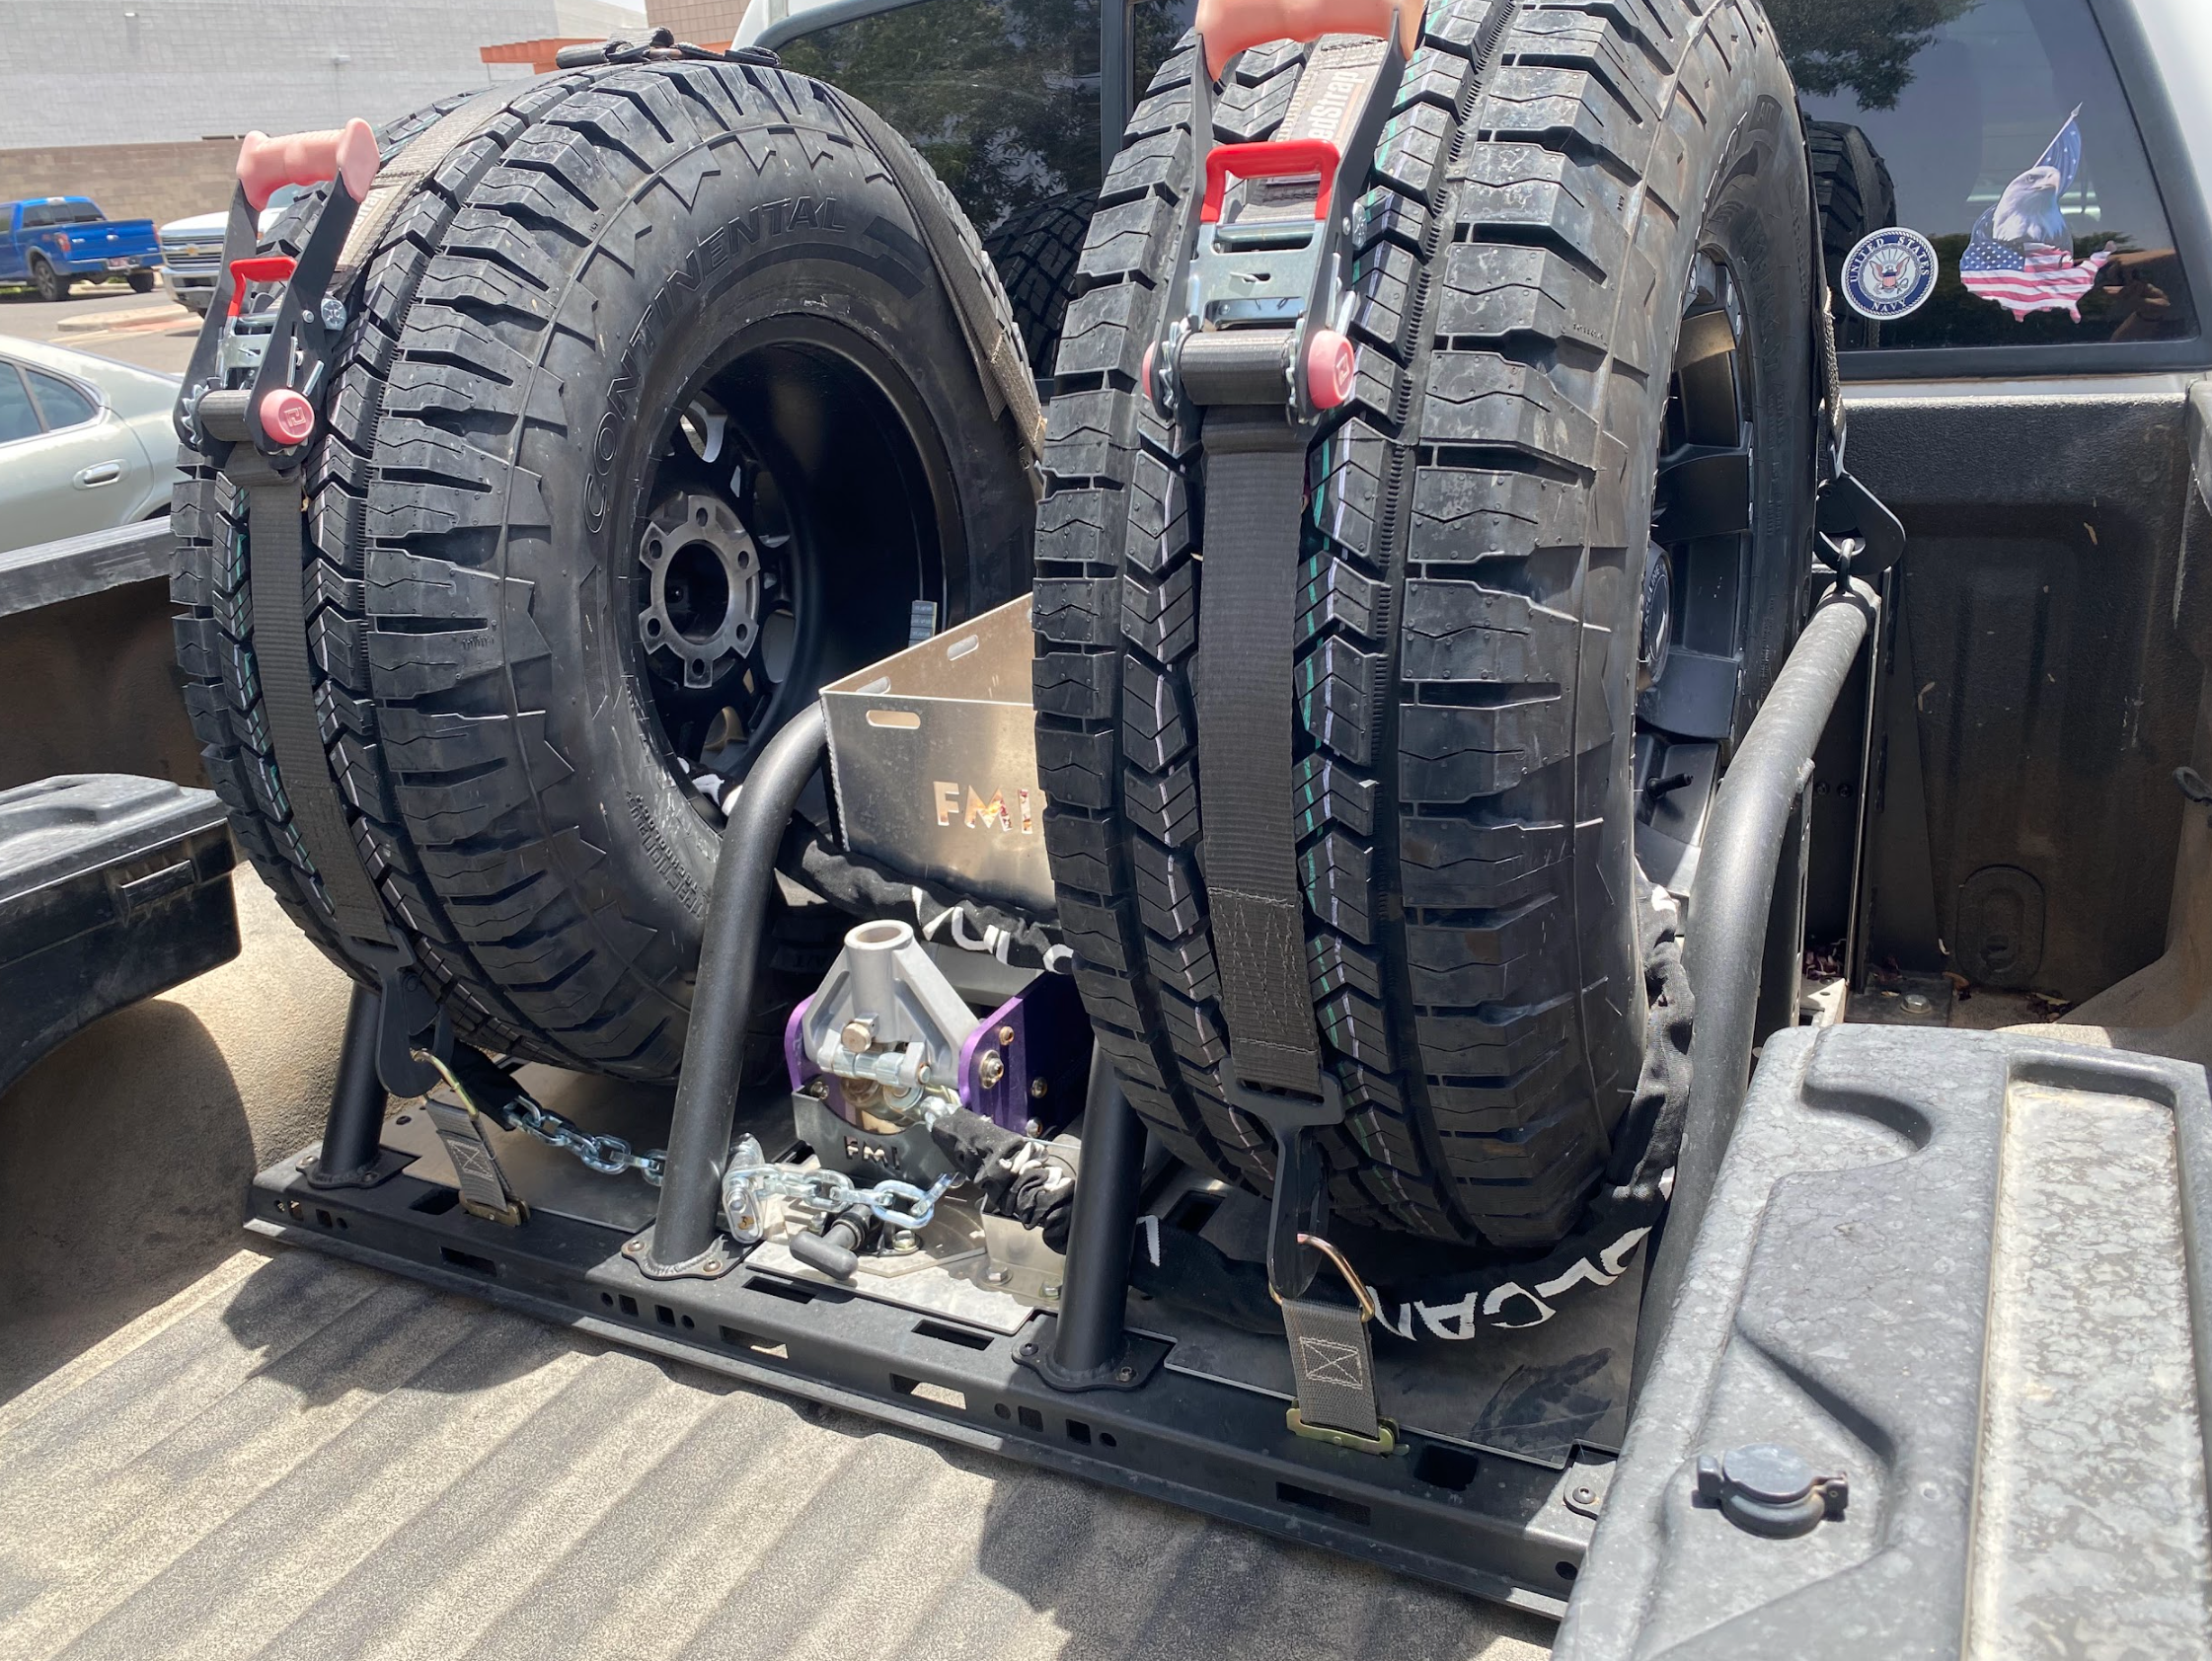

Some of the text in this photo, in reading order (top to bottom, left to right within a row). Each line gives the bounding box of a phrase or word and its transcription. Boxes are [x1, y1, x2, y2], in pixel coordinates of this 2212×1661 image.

[1307, 71, 1366, 140] edStrap
[1850, 238, 1884, 283] UNITED
[1897, 237, 1930, 276] STATES
[1871, 297, 1906, 312] NAVY
[584, 195, 846, 533] CONTINENTAL
[933, 781, 1033, 835] FMI
[844, 1135, 900, 1170] FMI
[1367, 1226, 1653, 1341] ULCAN
